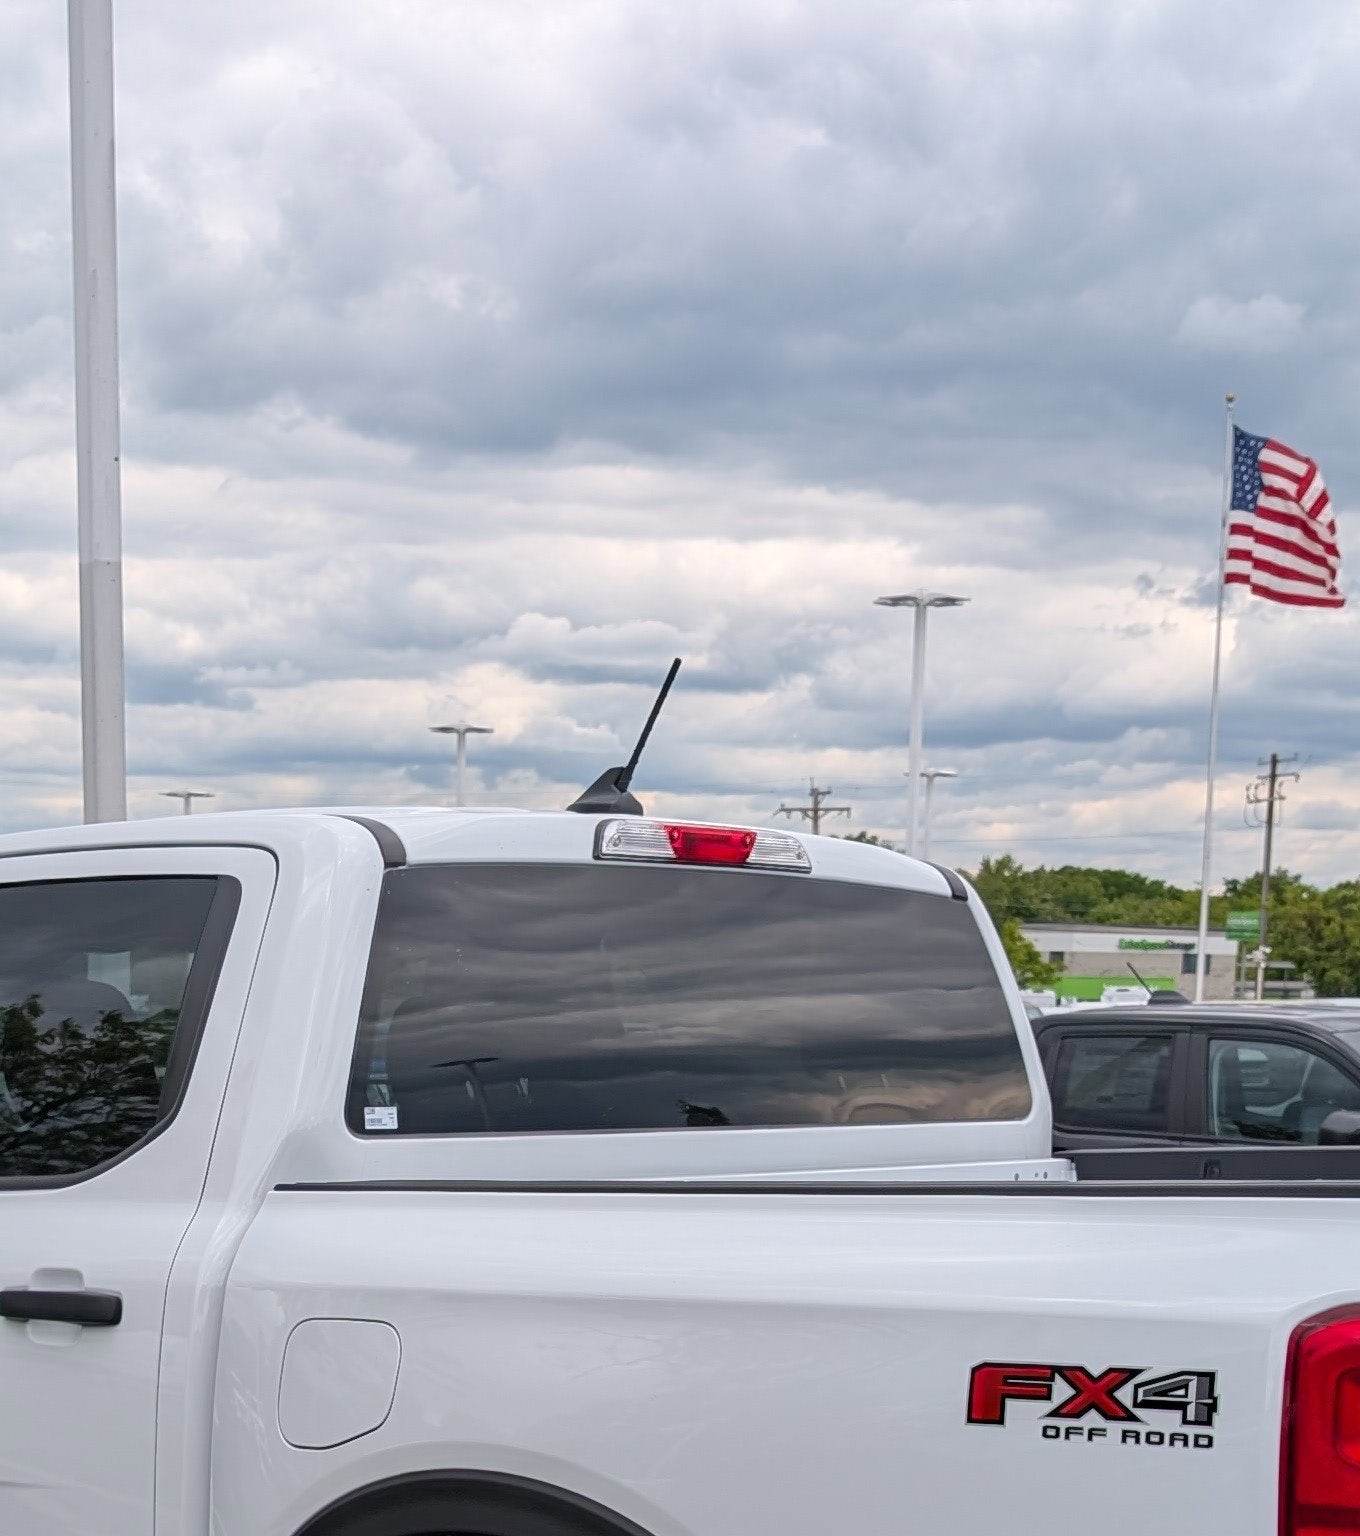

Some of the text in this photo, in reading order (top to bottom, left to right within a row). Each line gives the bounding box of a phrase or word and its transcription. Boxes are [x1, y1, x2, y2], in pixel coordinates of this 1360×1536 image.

[966, 1361, 1218, 1427] FX4
[1041, 1425, 1214, 1449] OFF ROAD
